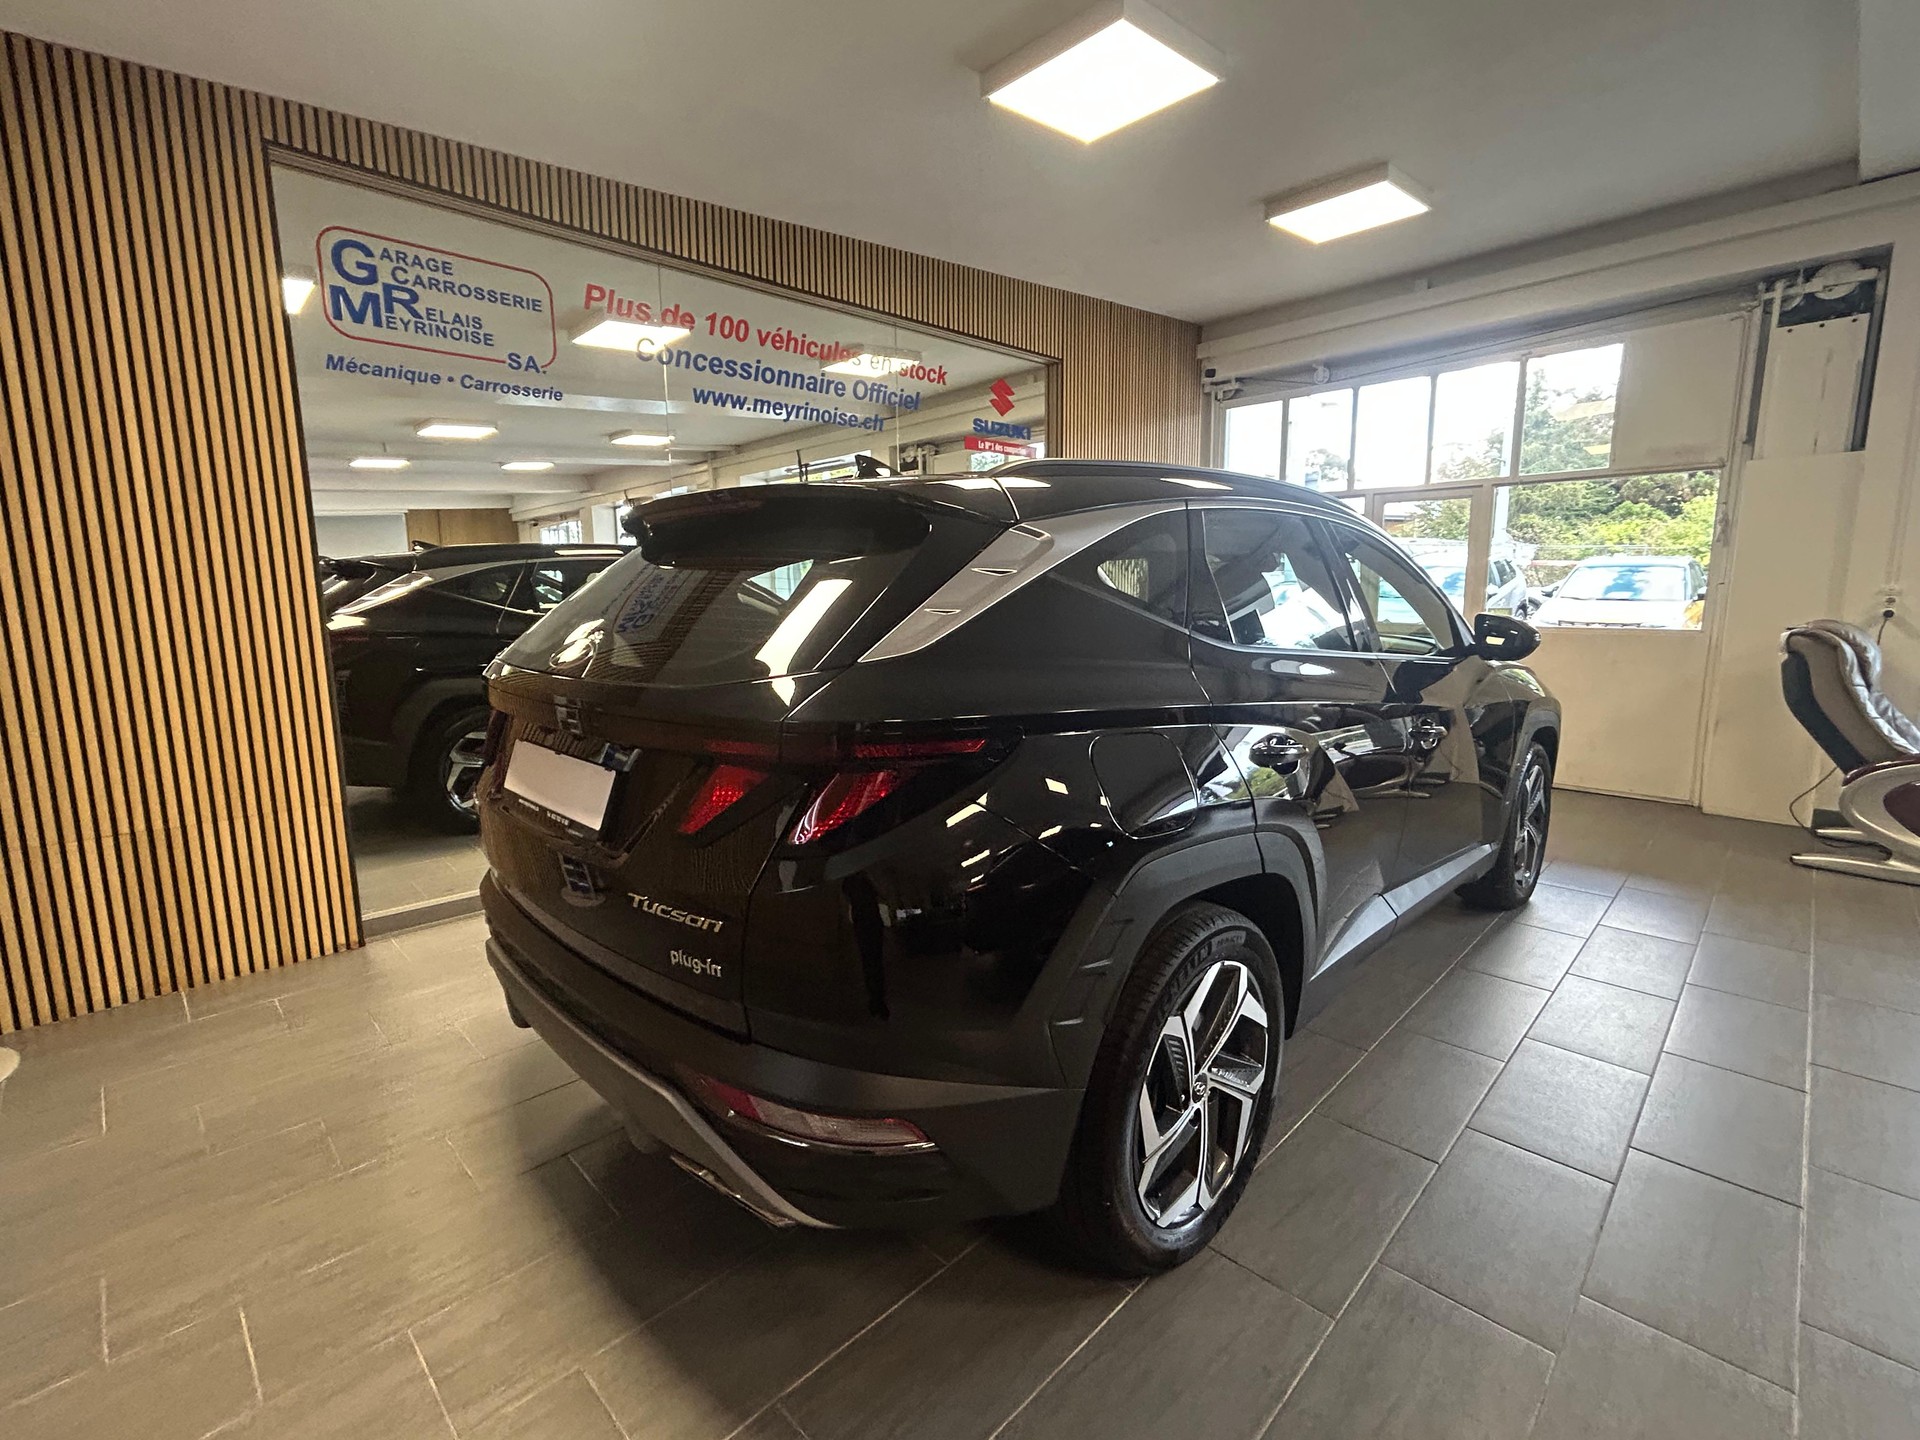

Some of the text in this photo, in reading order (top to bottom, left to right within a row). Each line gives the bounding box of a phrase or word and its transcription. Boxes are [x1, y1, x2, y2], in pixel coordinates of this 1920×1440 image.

[330, 239, 453, 286] GARAGE
[382, 282, 483, 330] RELAIS
[391, 265, 543, 312] CARROSSERIE
[329, 284, 495, 347] MEYRINOISE
[583, 283, 948, 386] Plus de 100 véhicules en stock
[325, 353, 563, 401] Mécanique Carrosserie
[636, 337, 921, 411] Concessionnaire Officiel
[692, 387, 885, 432] www.meyrinoise.ch
[972, 418, 1031, 440] SUZUKI
[669, 950, 722, 977] plug-in
